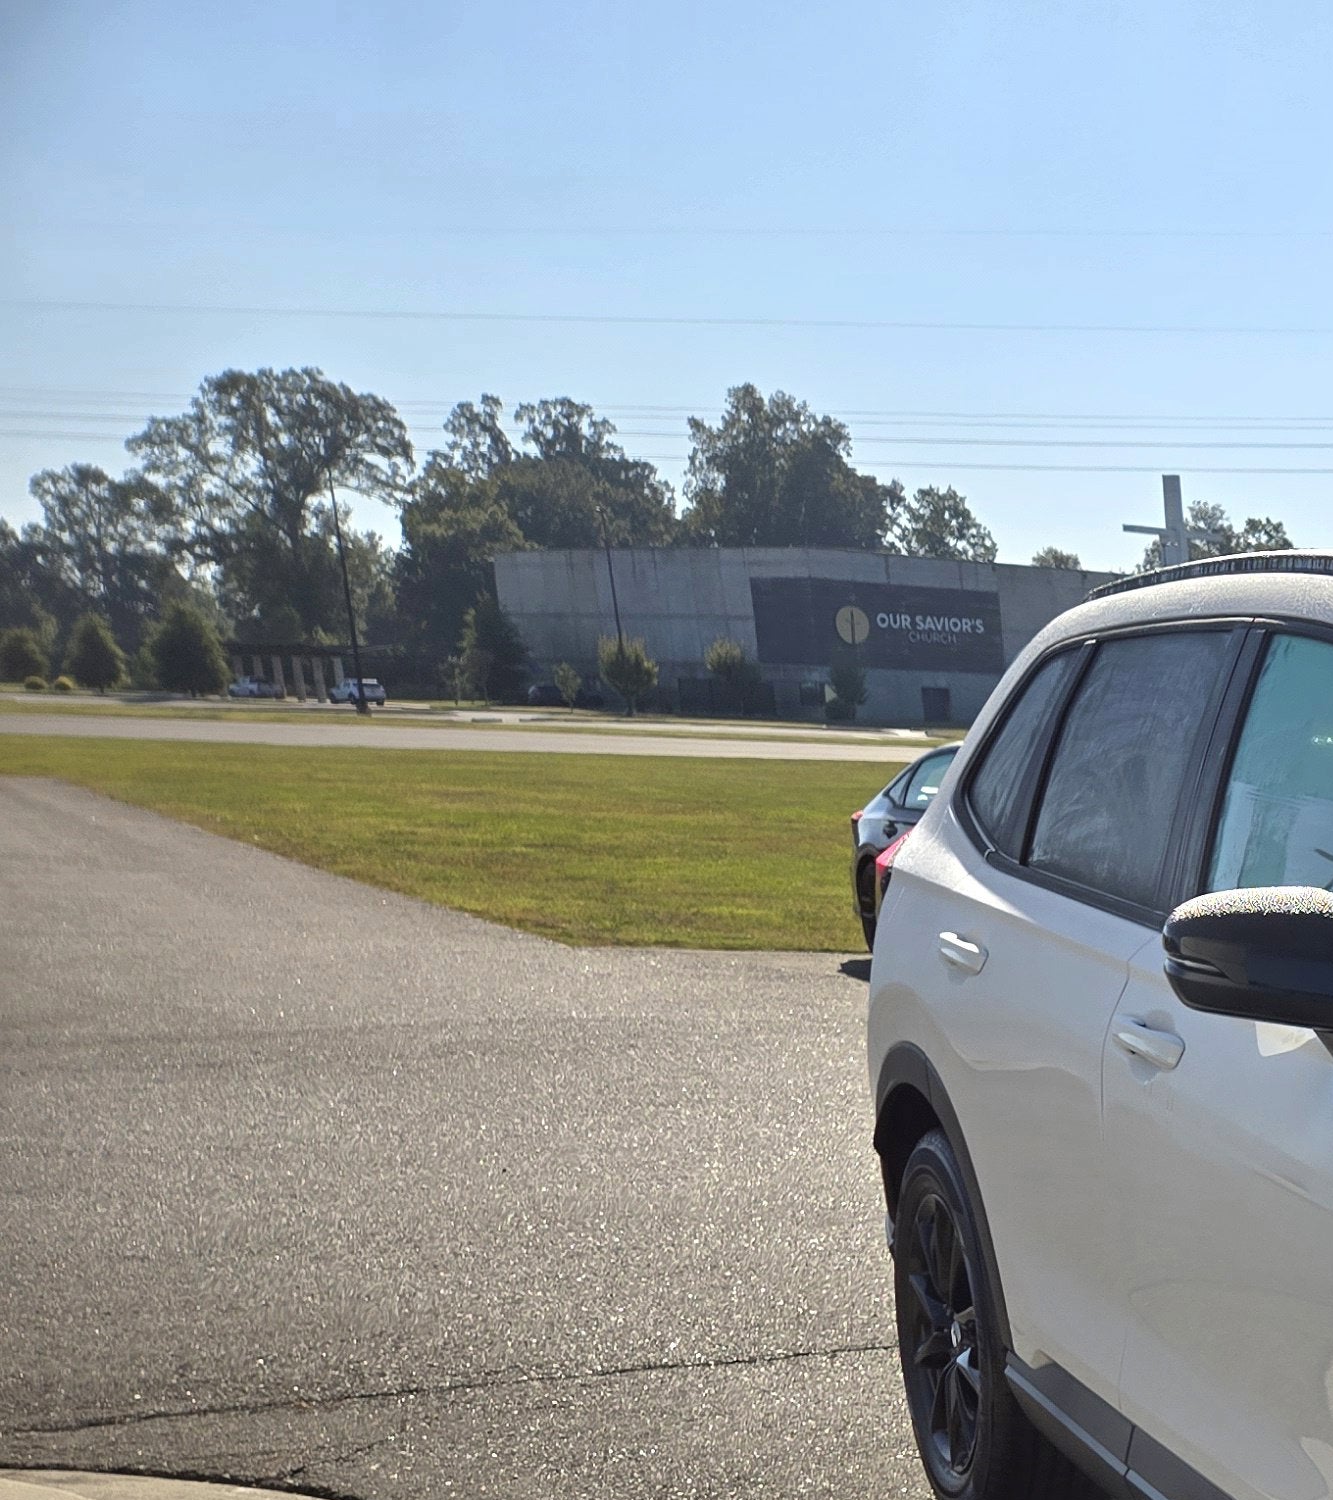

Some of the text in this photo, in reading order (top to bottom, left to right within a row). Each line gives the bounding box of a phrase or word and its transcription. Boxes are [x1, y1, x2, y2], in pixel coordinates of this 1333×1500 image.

[876, 612, 985, 634] OUR SAVIOR'S
[908, 630, 957, 645] CHURCH
